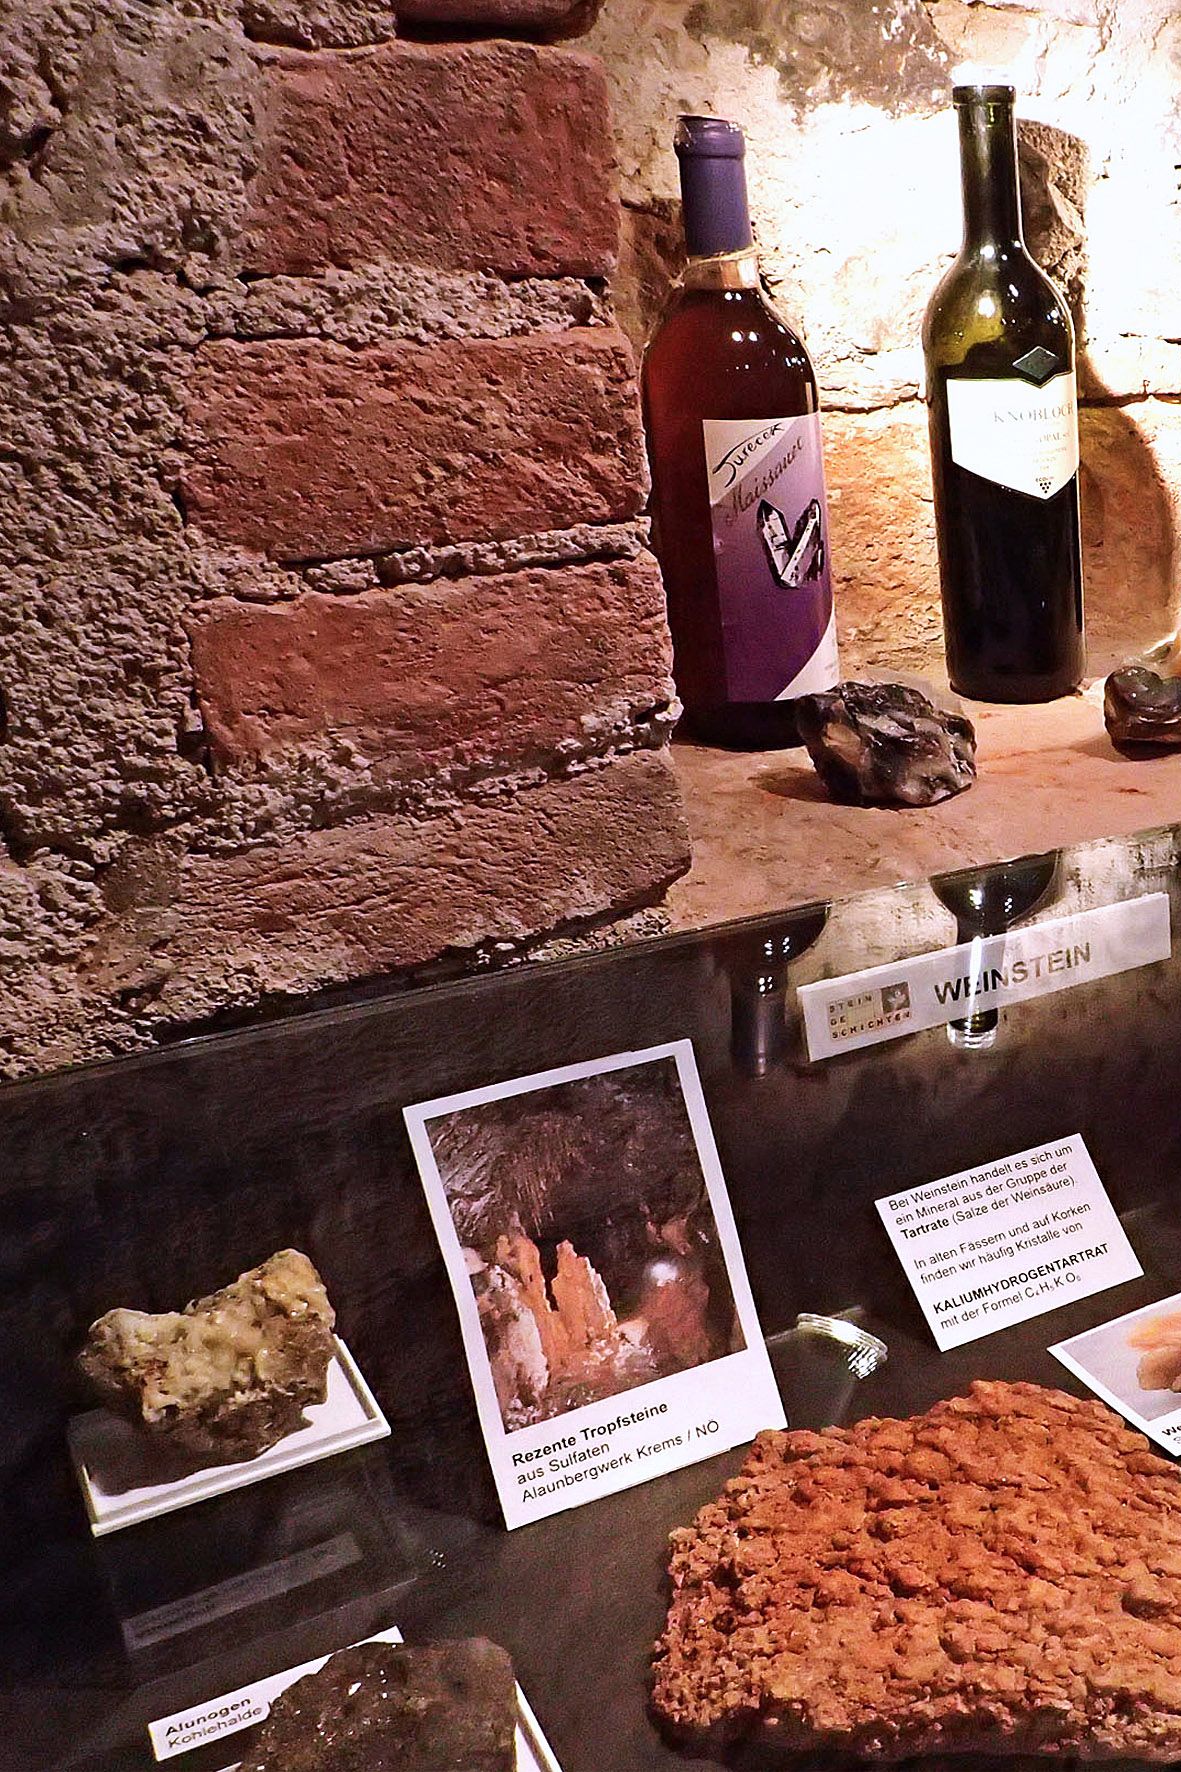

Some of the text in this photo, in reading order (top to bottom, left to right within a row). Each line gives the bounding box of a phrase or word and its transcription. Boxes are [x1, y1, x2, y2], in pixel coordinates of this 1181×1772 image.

[934, 942, 1092, 1005] WEINSTEIN
[888, 1145, 1073, 1211] Bei Weinstein handelt es sich um
[896, 1162, 1068, 1226] ein Mineral aus der Gruppe der
[900, 1217, 950, 1240] Tartrate
[952, 1204, 989, 1225] (Salze
[991, 1197, 1010, 1212] der
[913, 1202, 1091, 1270] In alten Fässern und auf Korken
[920, 1268, 957, 1285] finden
[959, 1259, 978, 1273] wir
[1015, 1230, 1061, 1252] Kristalle
[1062, 1221, 1083, 1235] von
[933, 1243, 1110, 1315] KALIUMHYDROGENTARTRAT
[940, 1316, 960, 1330] mit
[961, 1309, 980, 1323] der
[982, 1292, 1024, 1315] Formel
[512, 1402, 669, 1467] Rezente Tropfsteine
[517, 1442, 610, 1486] aus Sulfaten
[522, 1453, 633, 1503] Alaunbergwerk
[637, 1436, 683, 1460] Krems
[695, 1419, 720, 1440] NÖ
[165, 1698, 251, 1737] Alunogen
